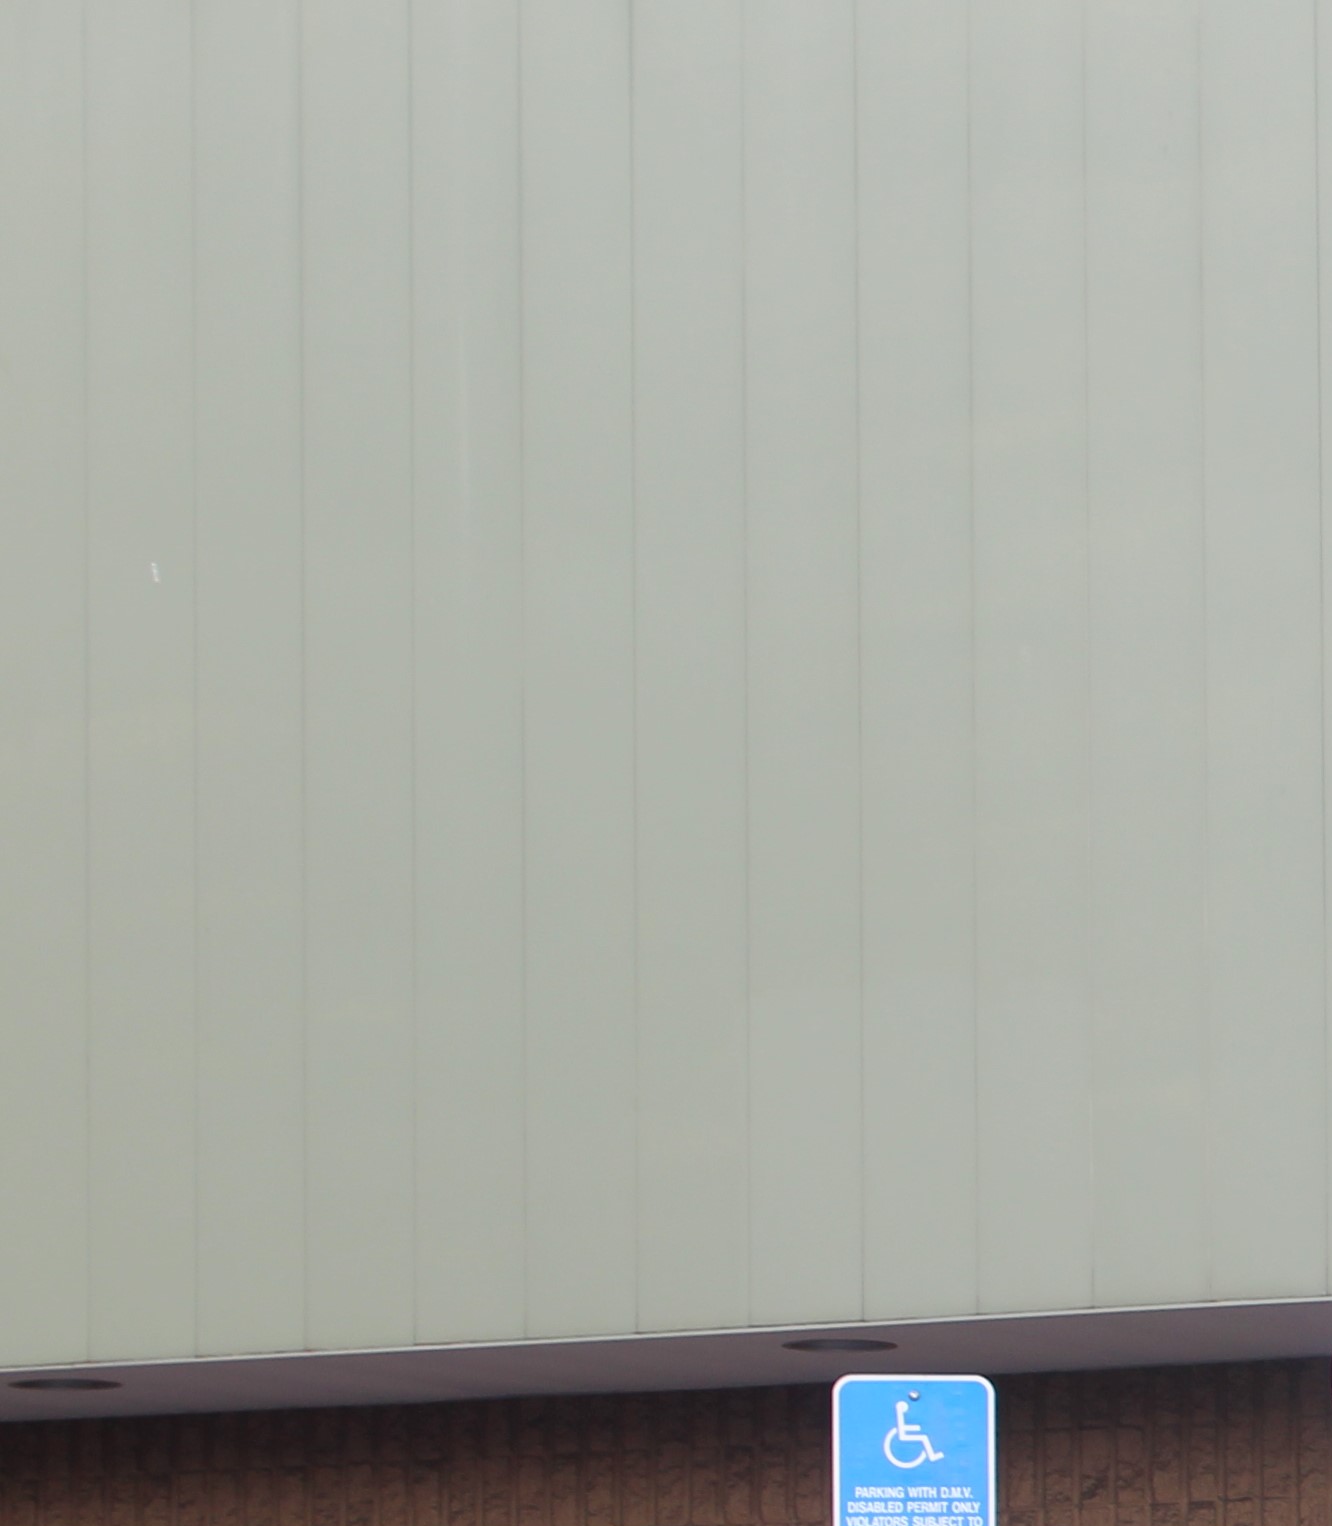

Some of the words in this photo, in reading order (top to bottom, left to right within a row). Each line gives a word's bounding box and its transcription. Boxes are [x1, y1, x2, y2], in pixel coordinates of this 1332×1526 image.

[855, 1486, 904, 1498] PARKING
[908, 1486, 937, 1498] WITH
[847, 1501, 903, 1513] DISABLED
[907, 1501, 948, 1513] PERMIT
[952, 1501, 980, 1513] ONLY
